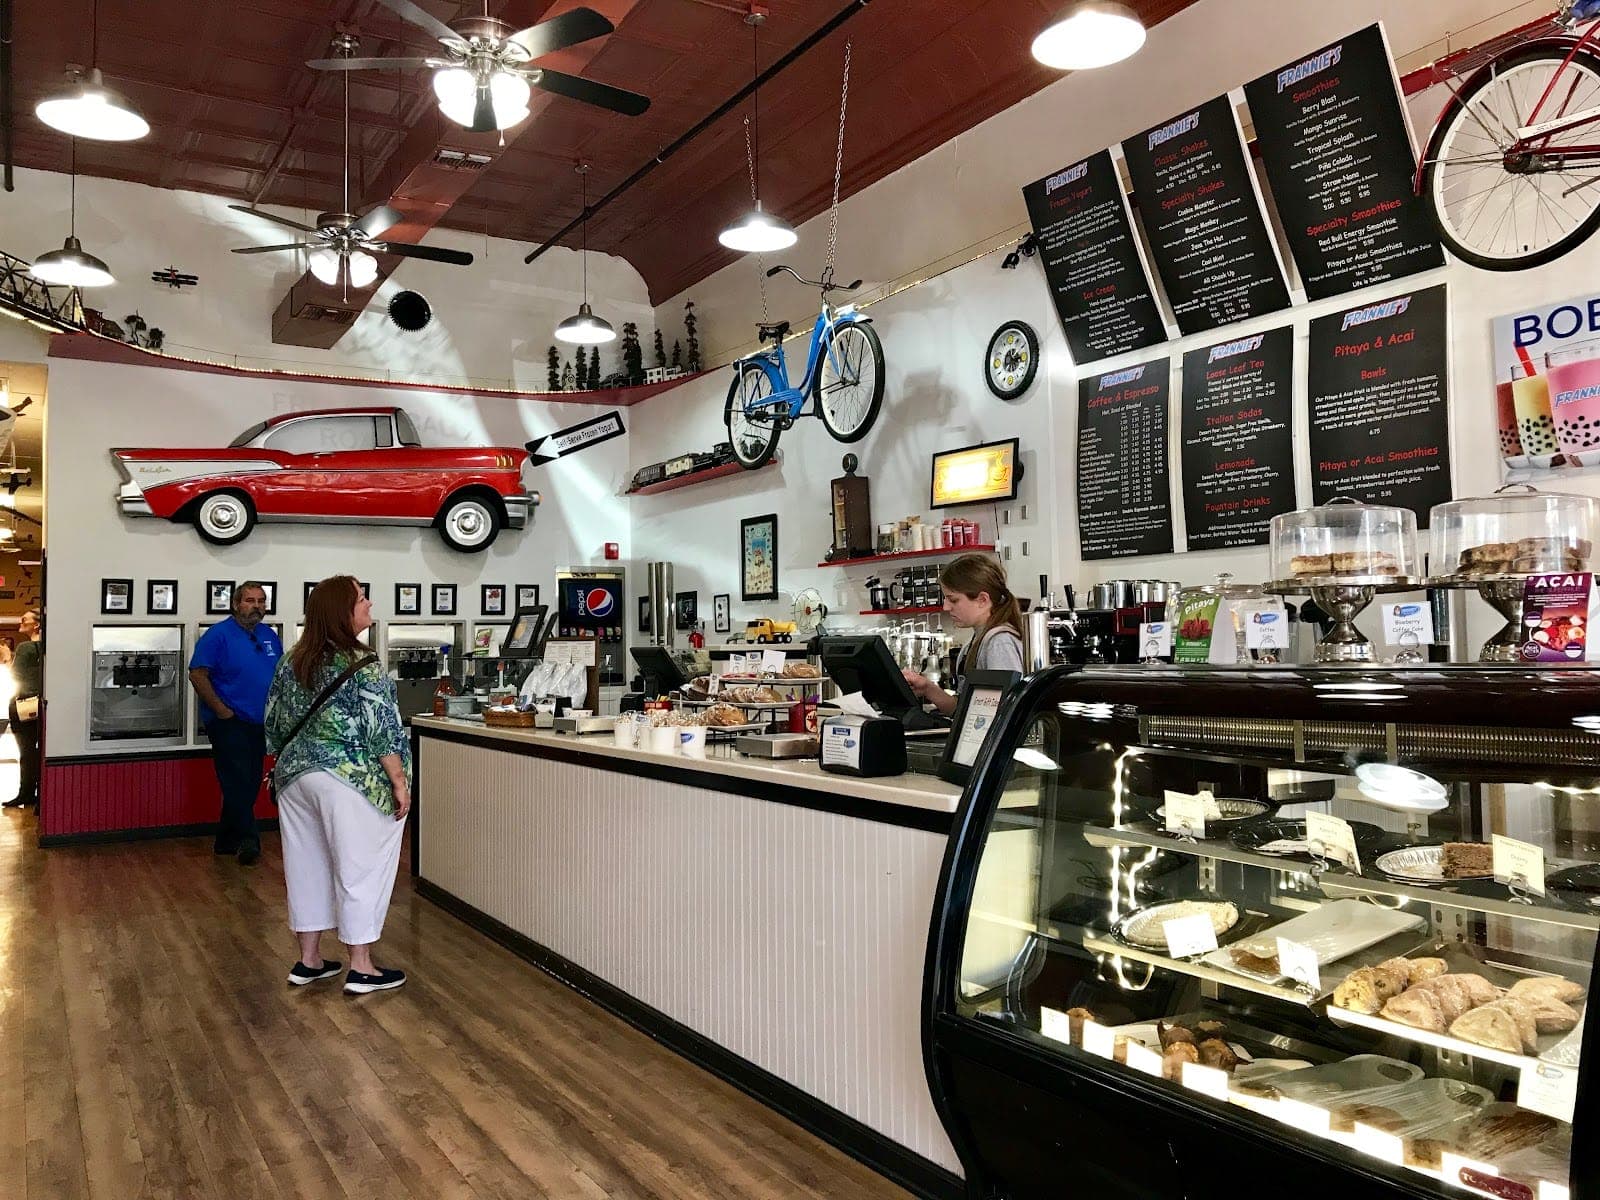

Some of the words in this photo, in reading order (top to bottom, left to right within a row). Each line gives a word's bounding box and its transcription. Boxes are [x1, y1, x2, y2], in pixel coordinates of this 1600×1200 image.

[1278, 46, 1341, 92] FRANNIE'S
[1293, 78, 1339, 103] Smoothies
[1302, 103, 1319, 114] Berry
[1321, 95, 1336, 106] Blast
[1149, 112, 1199, 150] FRANNIE'S
[1304, 124, 1322, 135] Mango
[1324, 114, 1347, 127] Sunrise
[1155, 153, 1178, 167] Classic
[1181, 140, 1208, 155] Shakes
[1307, 139, 1332, 154] Tropical
[1333, 132, 1354, 145] Splash
[1332, 154, 1353, 166] Colada
[1046, 162, 1087, 194] FRANNIE'S
[1162, 192, 1194, 209] Specialty
[1197, 181, 1224, 195] Shakes
[1307, 217, 1347, 236] Specialty
[1352, 200, 1401, 221] Smoothies
[1319, 237, 1331, 246] Red
[1331, 233, 1343, 242] Bull
[1343, 228, 1365, 239] Energy
[1366, 218, 1396, 231] Smoothie
[1202, 258, 1212, 266] Cool
[1327, 259, 1345, 268] Pitaya
[1355, 251, 1368, 260] Acai
[1370, 242, 1403, 256] Smoothies
[1095, 285, 1115, 295] Cream
[1342, 297, 1411, 330] FRANNIE'S
[1208, 335, 1263, 363] FRANNIE'S
[1335, 342, 1369, 356] Pitaya
[1374, 336, 1382, 348] &
[1388, 329, 1414, 345] Acai
[1206, 369, 1226, 379] Loose
[1229, 362, 1246, 373] Leaf
[1249, 360, 1264, 368] Tea
[1361, 367, 1386, 379] Bowls
[1088, 396, 1112, 408] Coffee
[1115, 392, 1120, 401] &
[1124, 386, 1158, 399] Espresso
[1555, 385, 1600, 408] FRANN
[598, 422, 614, 434] Yogurt
[1207, 415, 1233, 425] Italian
[1237, 409, 1262, 419] Sodas
[1216, 458, 1255, 470] Lemonade
[1320, 461, 1346, 471] Pitaya
[1350, 459, 1359, 467] or
[1365, 456, 1384, 464] Acai
[1388, 448, 1437, 461] Smoothies
[1206, 502, 1239, 512] Fountain
[1243, 497, 1270, 507] Drinks
[1534, 576, 1584, 588] ACAI
[577, 590, 586, 616] pepsi
[1184, 598, 1216, 615] Pitaya
